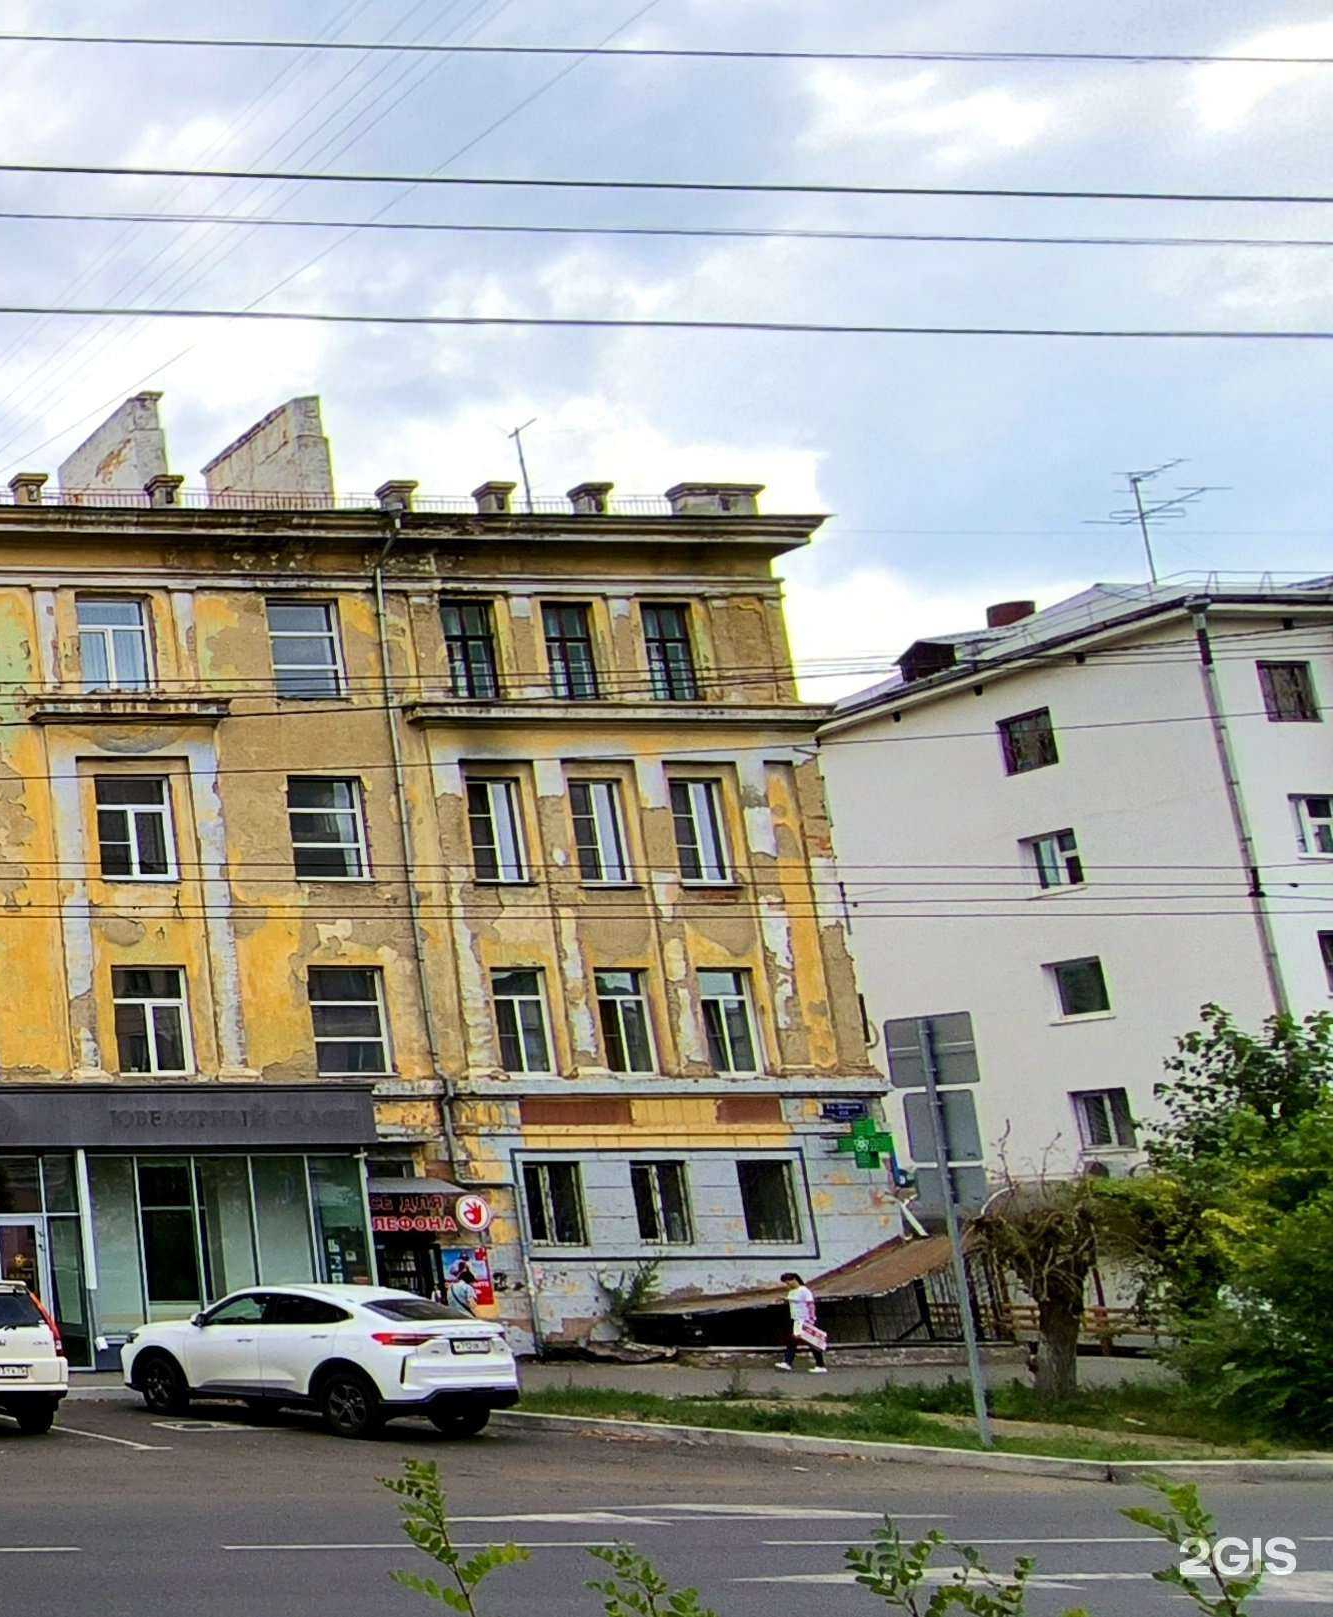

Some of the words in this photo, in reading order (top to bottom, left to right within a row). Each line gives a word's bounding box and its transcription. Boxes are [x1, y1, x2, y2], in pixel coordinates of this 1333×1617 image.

[370, 1195, 392, 1210] СЕ
[400, 1194, 445, 1213] ДЛЯ
[372, 1216, 458, 1231] ЛЕФОНА
